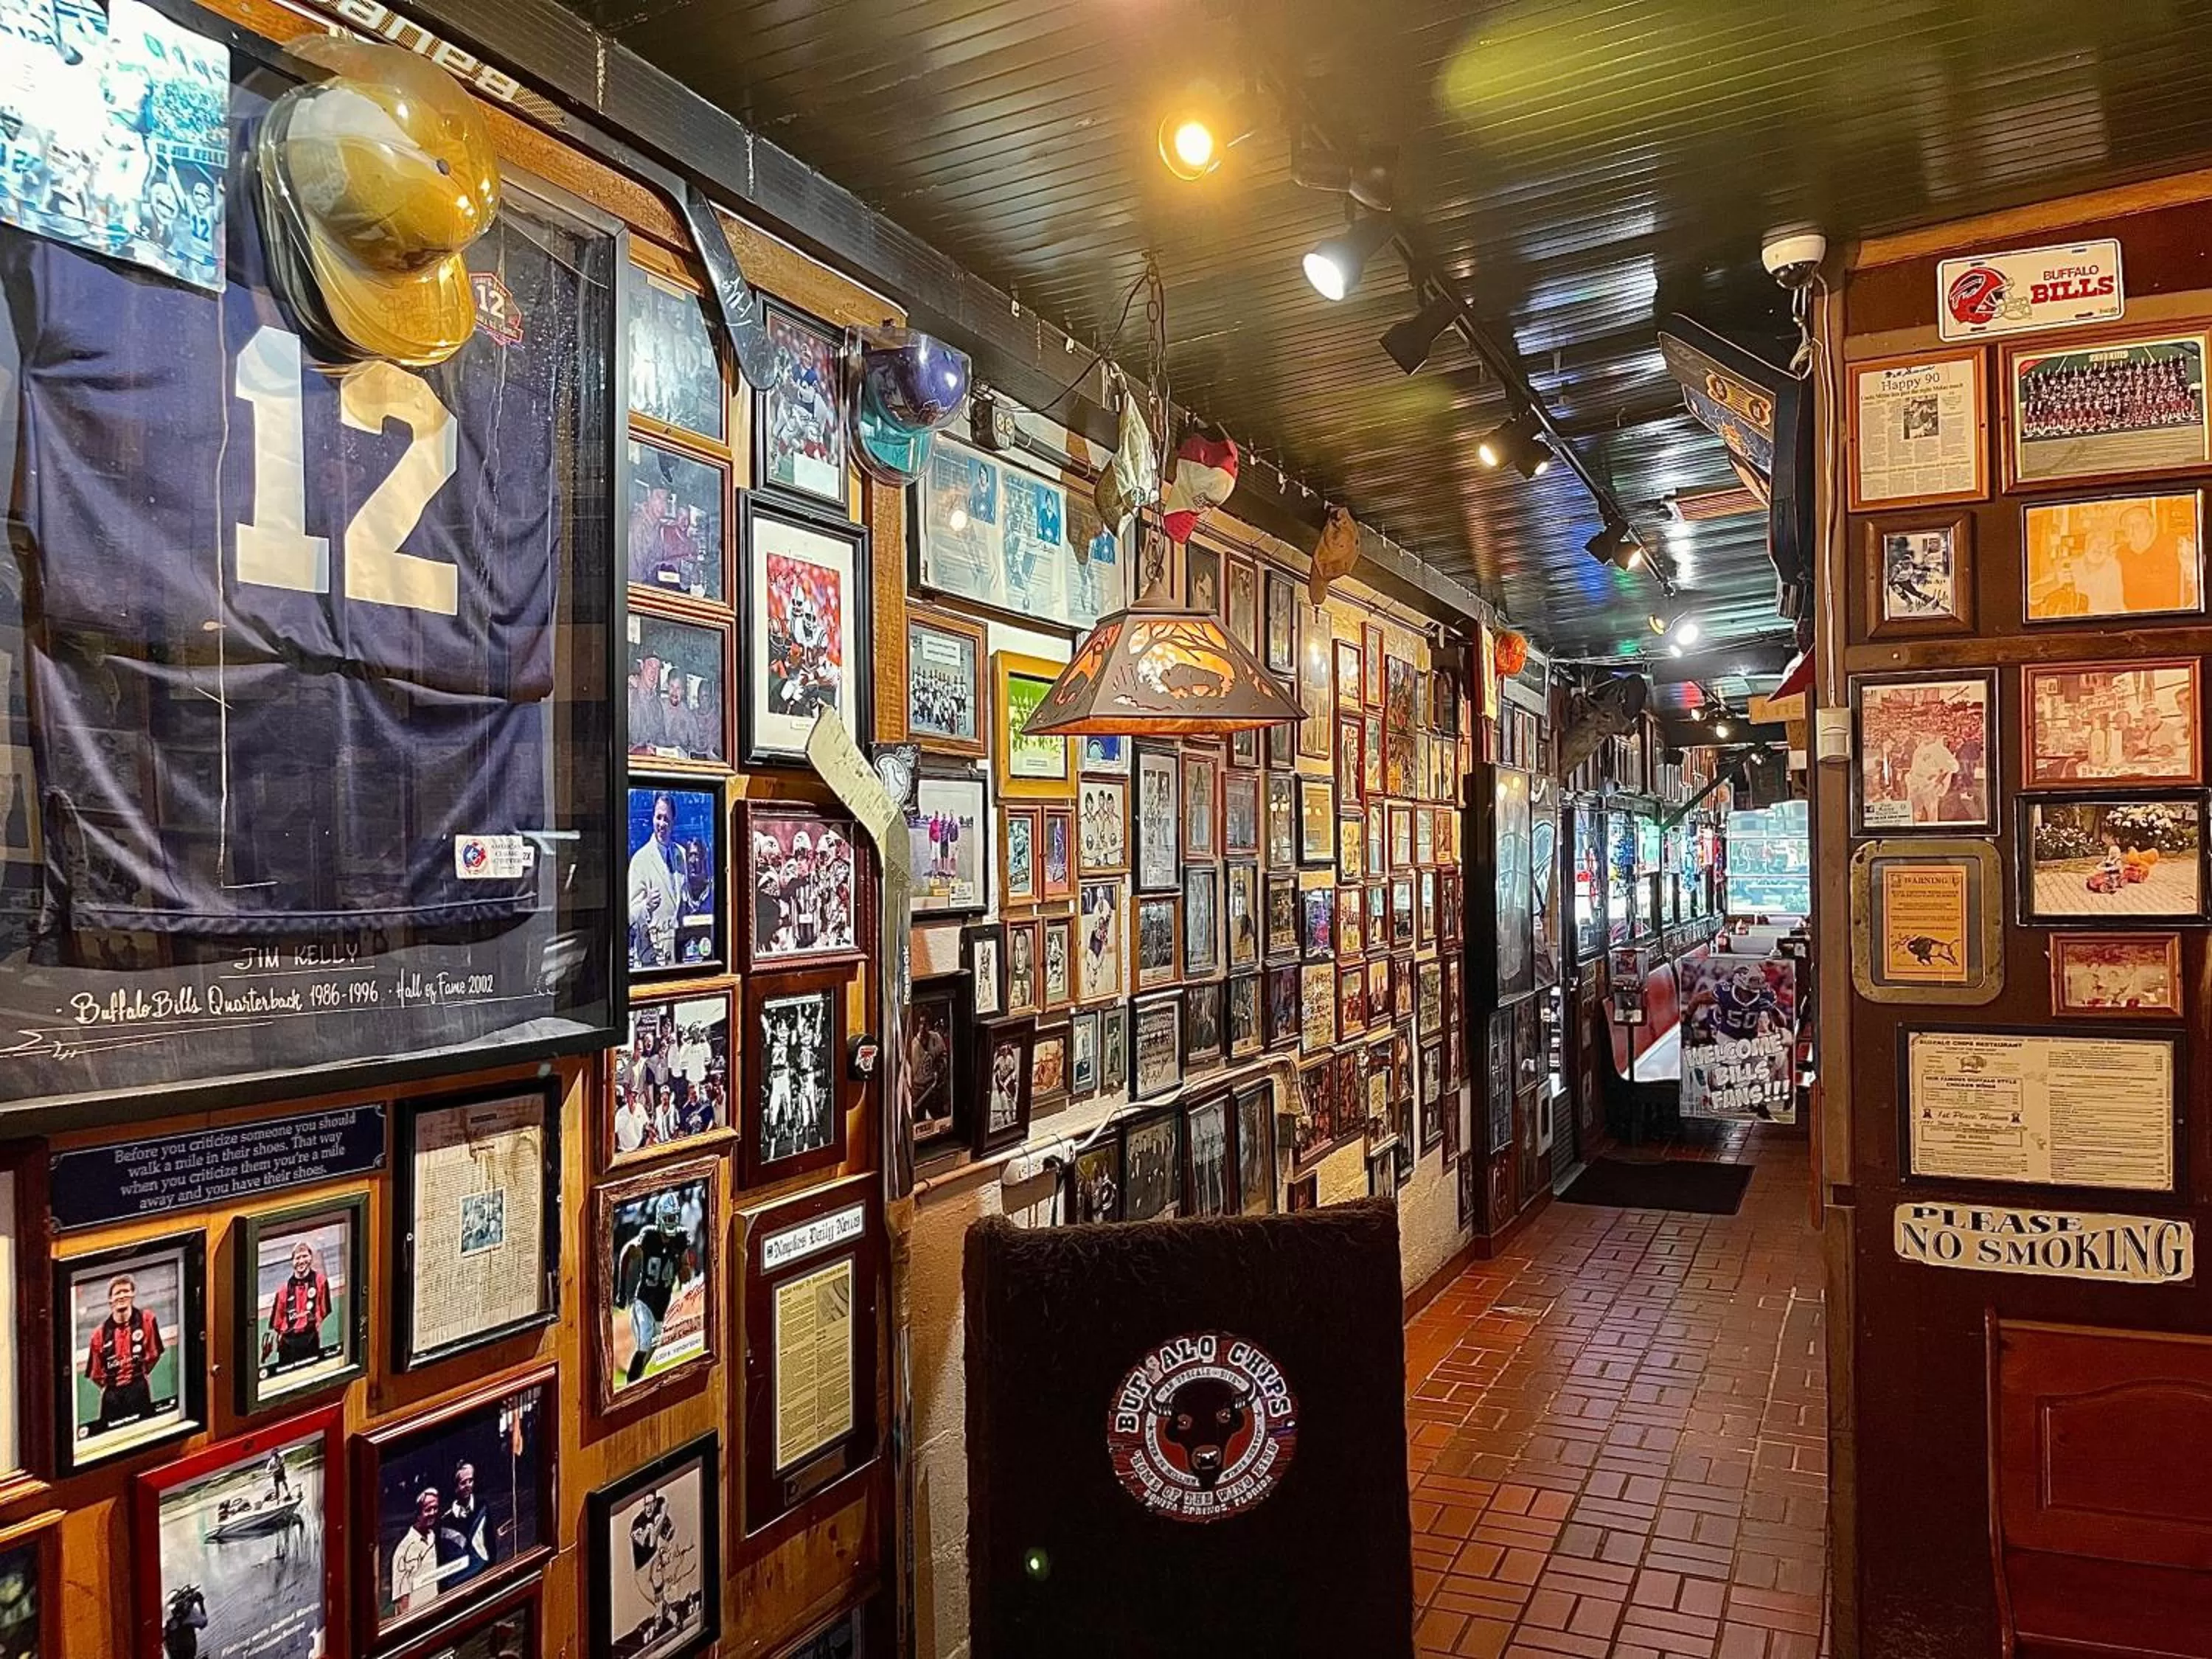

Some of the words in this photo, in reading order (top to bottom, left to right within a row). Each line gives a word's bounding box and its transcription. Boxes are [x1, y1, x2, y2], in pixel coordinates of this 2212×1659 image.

[2030, 274, 2115, 305] BILLS
[2043, 265, 2099, 281] BUFFALO
[476, 283, 505, 320] 12
[1881, 377, 1921, 392] Happy
[1924, 372, 1941, 384] 90
[235, 324, 458, 616] 12
[1904, 877, 1948, 885] WARNING
[233, 946, 279, 970] JIM
[294, 943, 358, 966] KELLY
[902, 945, 911, 1005] Reebok
[70, 988, 153, 1025] Buffalo
[151, 984, 203, 1018] Bills
[207, 984, 302, 1015] Quarterback
[310, 980, 378, 1006] 1986-1996
[397, 967, 422, 1009] Hall
[425, 980, 438, 1005] of
[436, 971, 466, 998] Fame
[468, 974, 494, 994] 2002
[1726, 1009, 1759, 1029] 50
[1684, 1033, 1784, 1068] WELCOME
[1714, 1060, 1770, 1087] BILLS
[1711, 1079, 1790, 1110] FANS!!!
[114, 1147, 159, 1164] Before
[161, 1143, 187, 1161] you
[189, 1133, 238, 1152] criticize
[240, 1125, 293, 1143] someone
[295, 1121, 317, 1136] you
[319, 1111, 357, 1129] should
[128, 1160, 161, 1178] walk
[164, 1163, 172, 1172] a
[175, 1153, 204, 1171] mile
[206, 1152, 220, 1165] in
[222, 1145, 250, 1162] their
[253, 1141, 289, 1157] shoes.
[291, 1135, 318, 1149] That
[320, 1131, 343, 1144] way
[120, 1180, 159, 1197] when
[161, 1175, 187, 1194] you
[189, 1166, 238, 1183] criticize
[241, 1159, 271, 1175] them
[274, 1151, 310, 1172] you're
[312, 1151, 319, 1161] a
[321, 1144, 346, 1159] mile
[139, 1193, 175, 1210] away
[178, 1185, 202, 1202] and
[206, 1183, 229, 1200] you
[232, 1177, 261, 1191] have
[263, 1169, 291, 1185] their
[293, 1164, 327, 1180] shoes.
[773, 1234, 807, 1259] Naples
[809, 1222, 834, 1245] Daily
[836, 1214, 860, 1235] News
[1911, 1206, 2084, 1235] PLEASE
[1900, 1222, 1962, 1261] NO
[1978, 1222, 2185, 1276] SMOKING
[647, 1256, 674, 1288] 94
[1115, 1335, 1217, 1433] BUFFALO
[1228, 1341, 1292, 1418] CHIPS
[1144, 1489, 1178, 1511] BONITA
[1234, 1475, 1274, 1507] FLORIDA
[1162, 1486, 1183, 1503] OF
[1184, 1490, 1213, 1506] THE
[1216, 1474, 1255, 1503] WING
